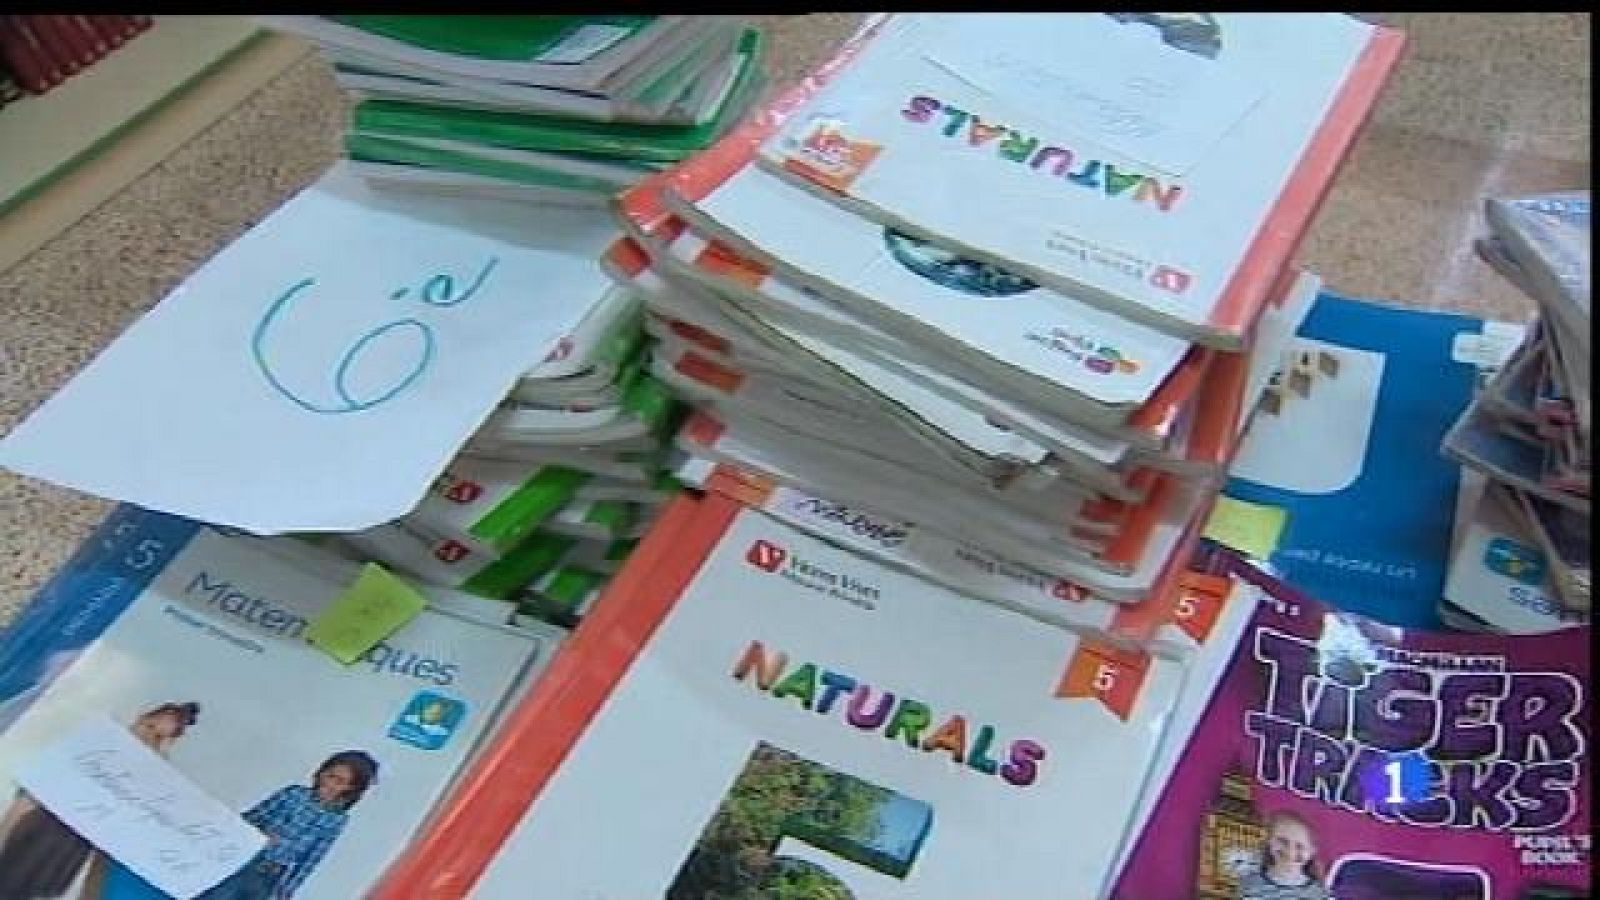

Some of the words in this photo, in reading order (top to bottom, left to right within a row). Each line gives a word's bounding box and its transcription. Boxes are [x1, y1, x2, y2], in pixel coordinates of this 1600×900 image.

[900, 96, 1184, 212] NATURALS
[1175, 595, 1200, 617] 5
[731, 639, 1046, 787] NATURALS
[1093, 663, 1120, 692] 5
